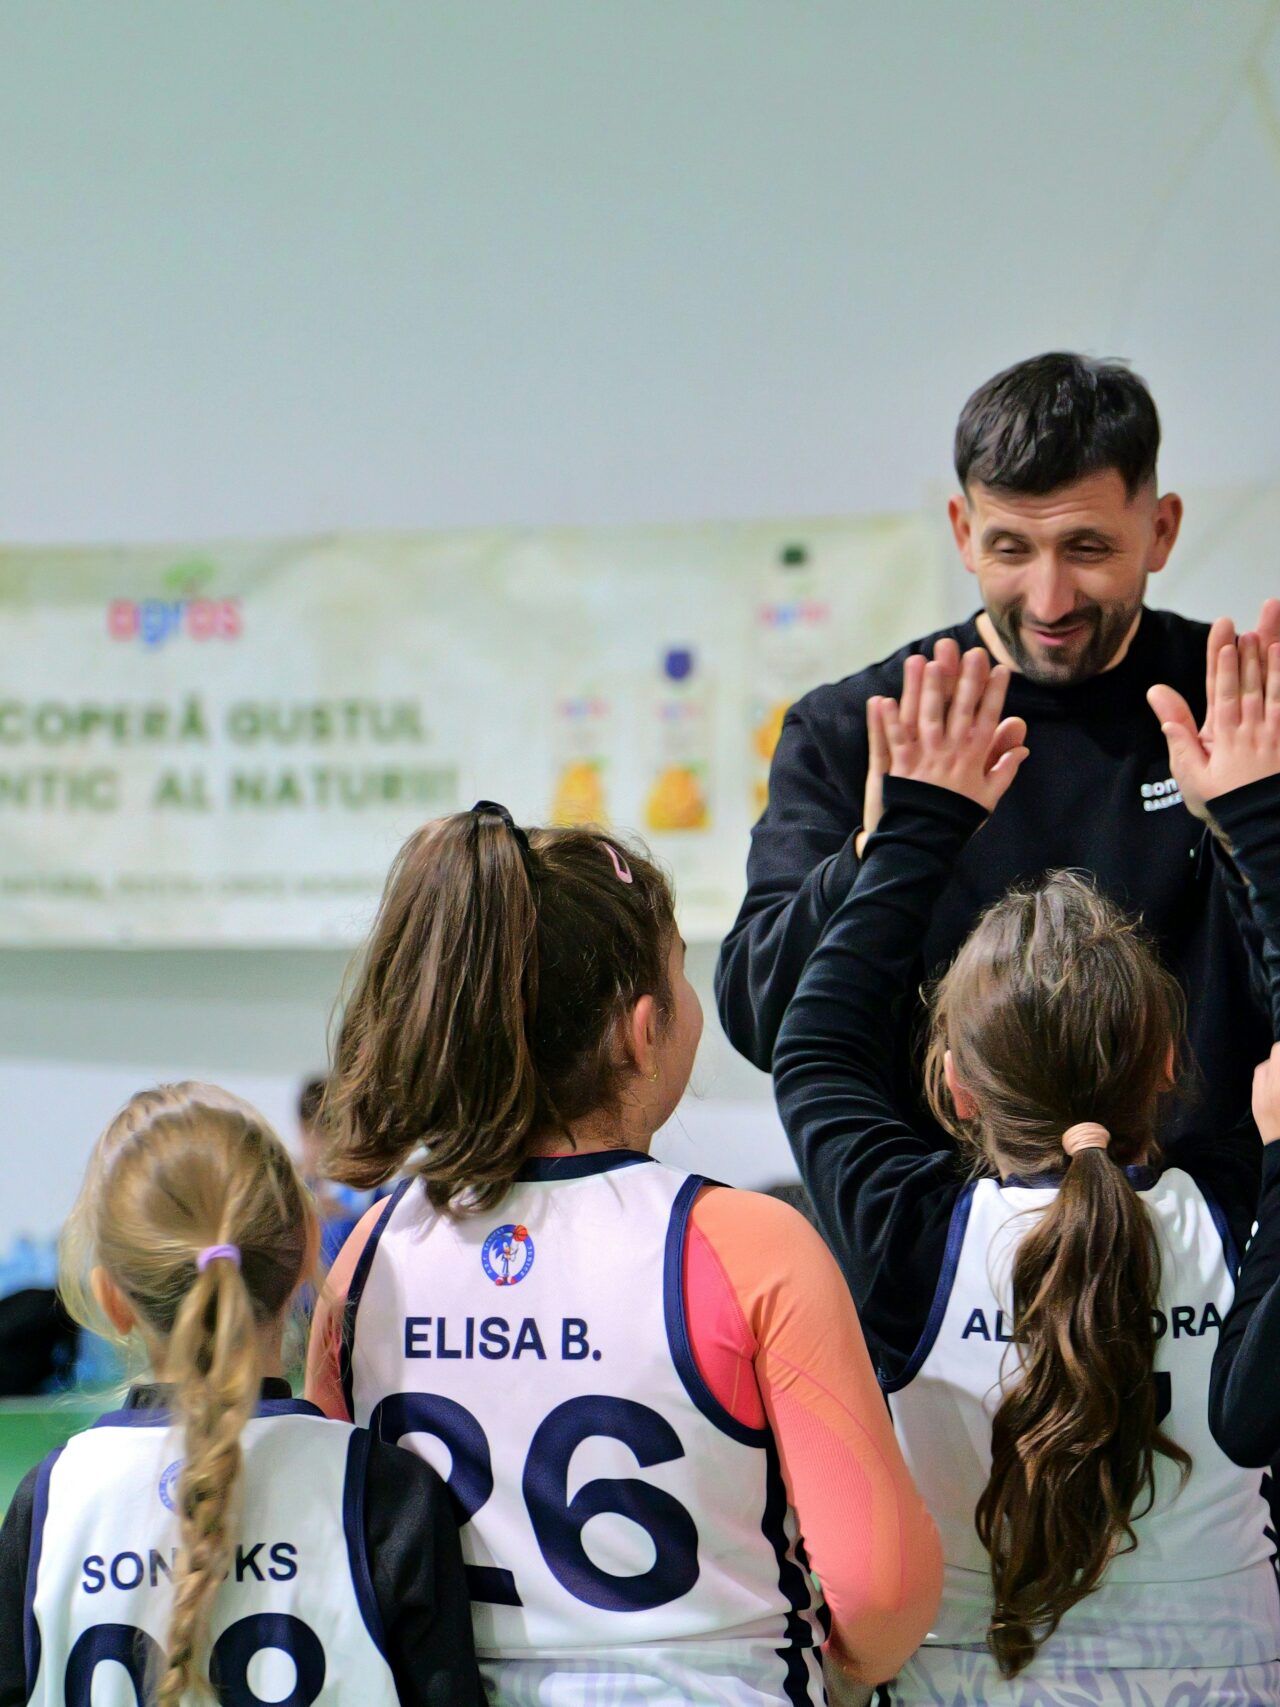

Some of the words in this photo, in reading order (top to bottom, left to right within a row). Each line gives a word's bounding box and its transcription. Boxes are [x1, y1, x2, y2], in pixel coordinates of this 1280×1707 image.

[227, 700, 425, 744] GUSTUL
[155, 768, 209, 809] AL
[404, 1316, 547, 1361] ELISA
[561, 1318, 602, 1362] B.
[369, 1391, 700, 1613] 26
[82, 1541, 298, 1595] SONKS
